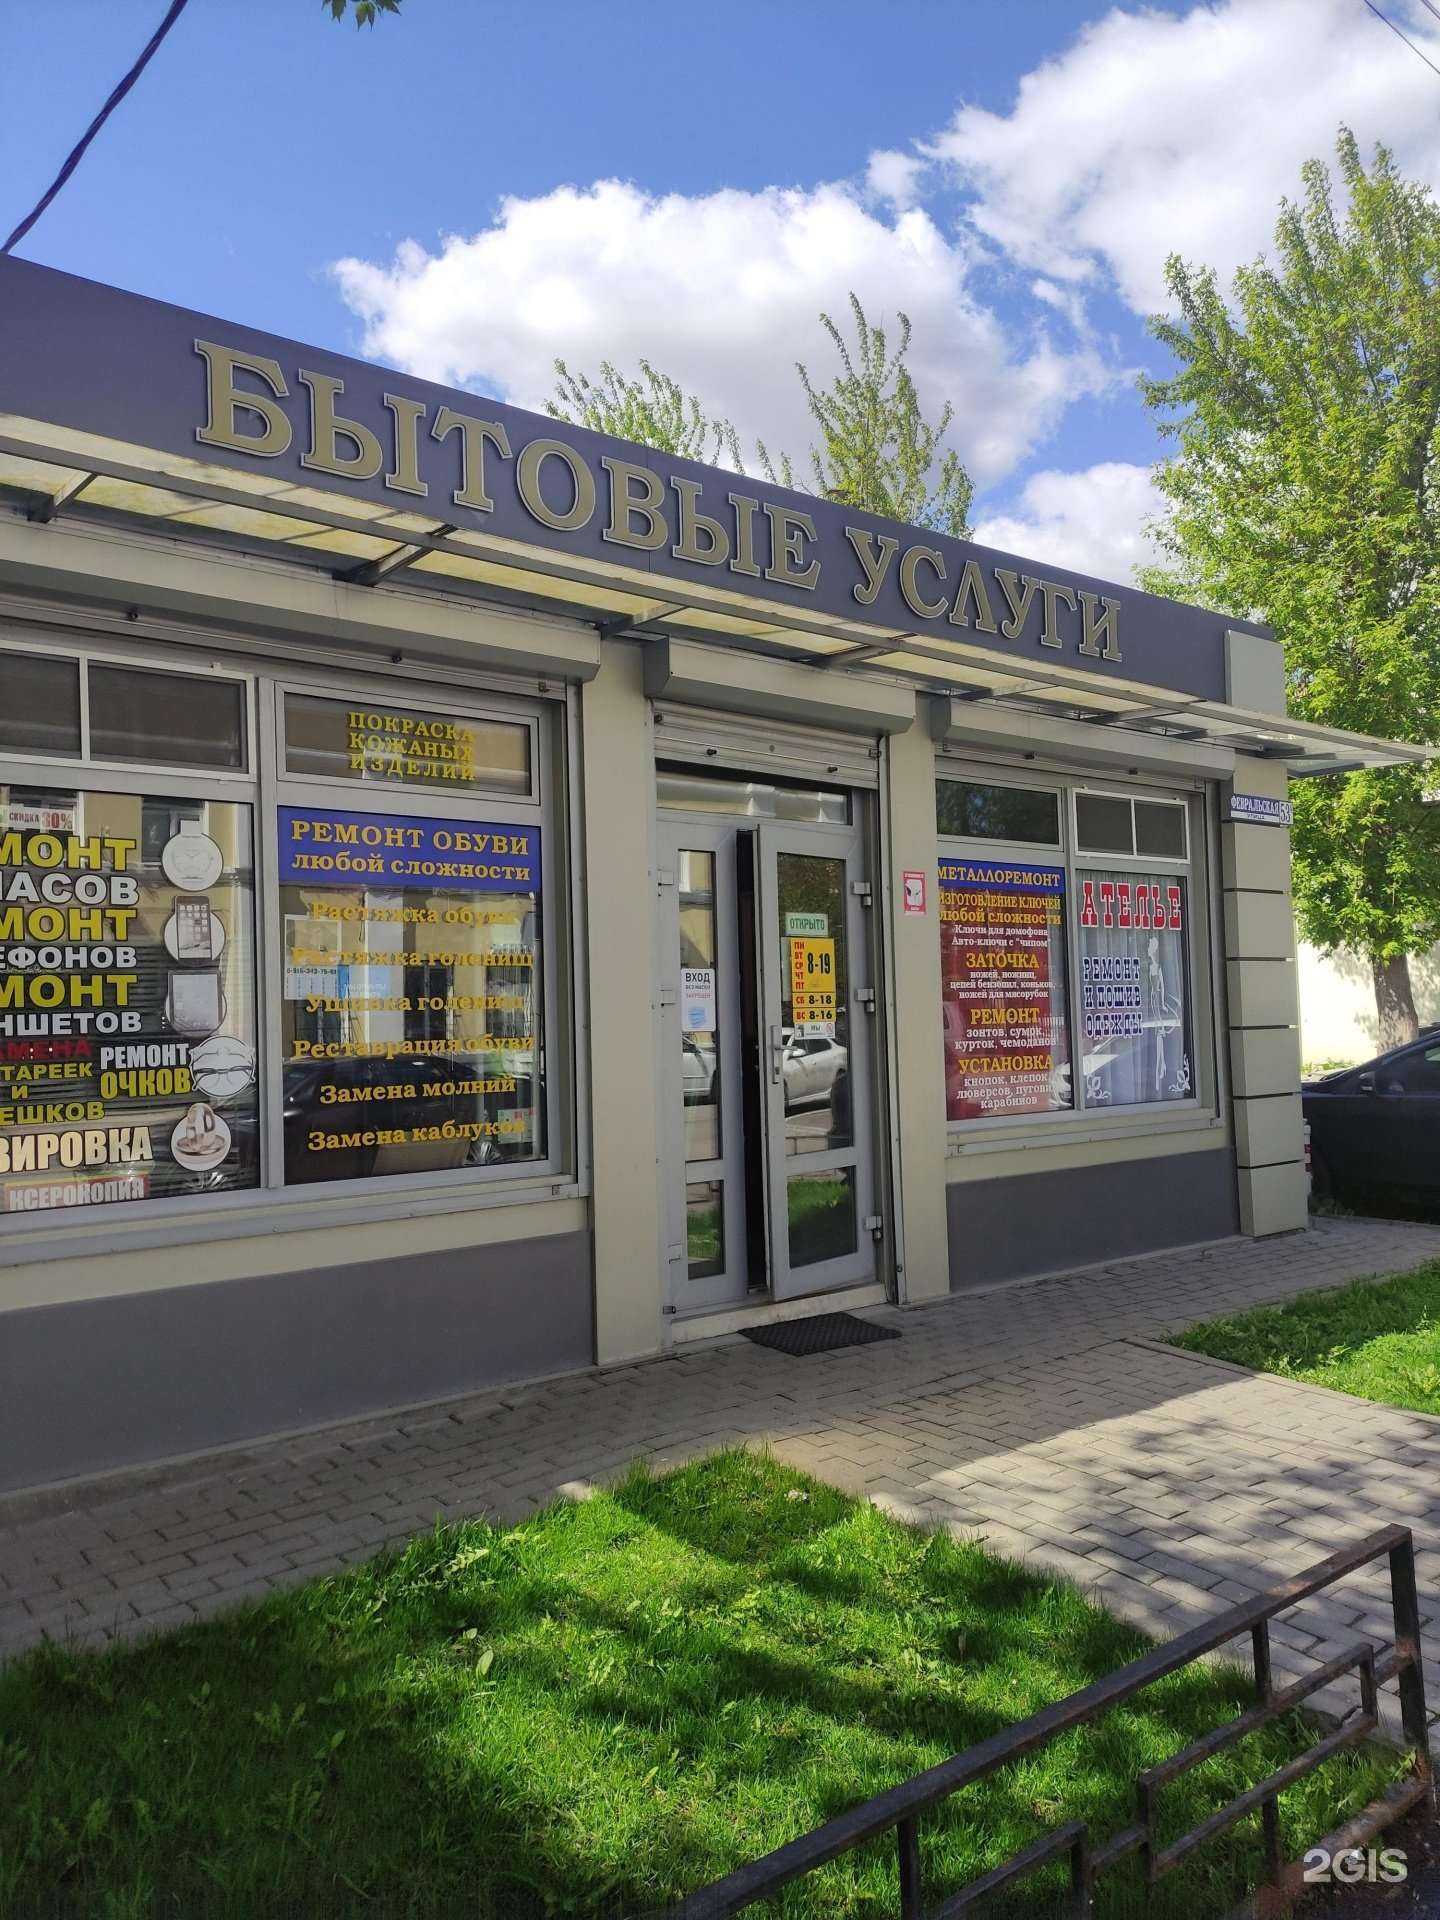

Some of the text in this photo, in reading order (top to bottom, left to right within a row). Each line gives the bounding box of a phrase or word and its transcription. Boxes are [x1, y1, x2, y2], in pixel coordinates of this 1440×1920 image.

[194, 338, 1123, 664] БЫТОВЫЕ УСЛУГИ
[349, 711, 476, 743] ПОКРАСКА
[1230, 796, 1280, 815] ФЕВРАЛЬСКАЯ
[9, 812, 39, 823] СКИДКА
[291, 819, 529, 856] РЕМОНТ ОБУВИ
[291, 850, 531, 881] любой сложности
[938, 866, 1061, 887] МЕТАЛЛОРЕМОНТ
[0, 870, 140, 906] АСОВ
[1019, 894, 1061, 910] КЛЮЧЕЙ
[1081, 880, 1182, 931] АТЕЛЬЕ
[789, 918, 825, 930] ОТКРЫТО
[987, 911, 1062, 925] сложности
[954, 924, 1049, 938] Ключи для домофона
[794, 941, 805, 951] ПН
[952, 936, 1008, 947] Авто-ключи
[794, 951, 803, 960] ВТ
[807, 952, 832, 975] 8-19
[966, 952, 1040, 969] ЗАТОЧКА
[795, 961, 804, 970] СР
[1082, 956, 1141, 982] РЕМОНТ
[685, 972, 711, 984] ВХОД
[795, 971, 804, 980] ЧТ
[795, 981, 805, 991] ПТ
[950, 980, 977, 990] цепей
[795, 994, 833, 1005] СБ 8-18
[958, 989, 1049, 1001] ножей для мясорубок
[1084, 984, 1142, 1010] И ПОШИВ
[796, 1009, 833, 1020] ВС 8-16
[970, 1007, 1041, 1025] РЕМОНТ
[966, 1027, 1008, 1038] зонтов,
[1086, 1011, 1144, 1040] ОДЕЖДЫ
[0, 1039, 92, 1061] МЕНА
[292, 1032, 535, 1060] Реставрация обуви
[954, 1038, 1057, 1052] курток, чемоданов
[100, 1043, 190, 1070] РЕМОНТ
[958, 1054, 1055, 1075] УСТАНОВКА
[100, 1067, 192, 1099] ОЧКОВ
[320, 1073, 516, 1105] Замена молний
[964, 1077, 1008, 1087] кнопок,
[11, 1085, 29, 1100] И
[308, 1127, 407, 1151] Замена
[9, 1177, 145, 1211] КСЕРОКОПИЯ
